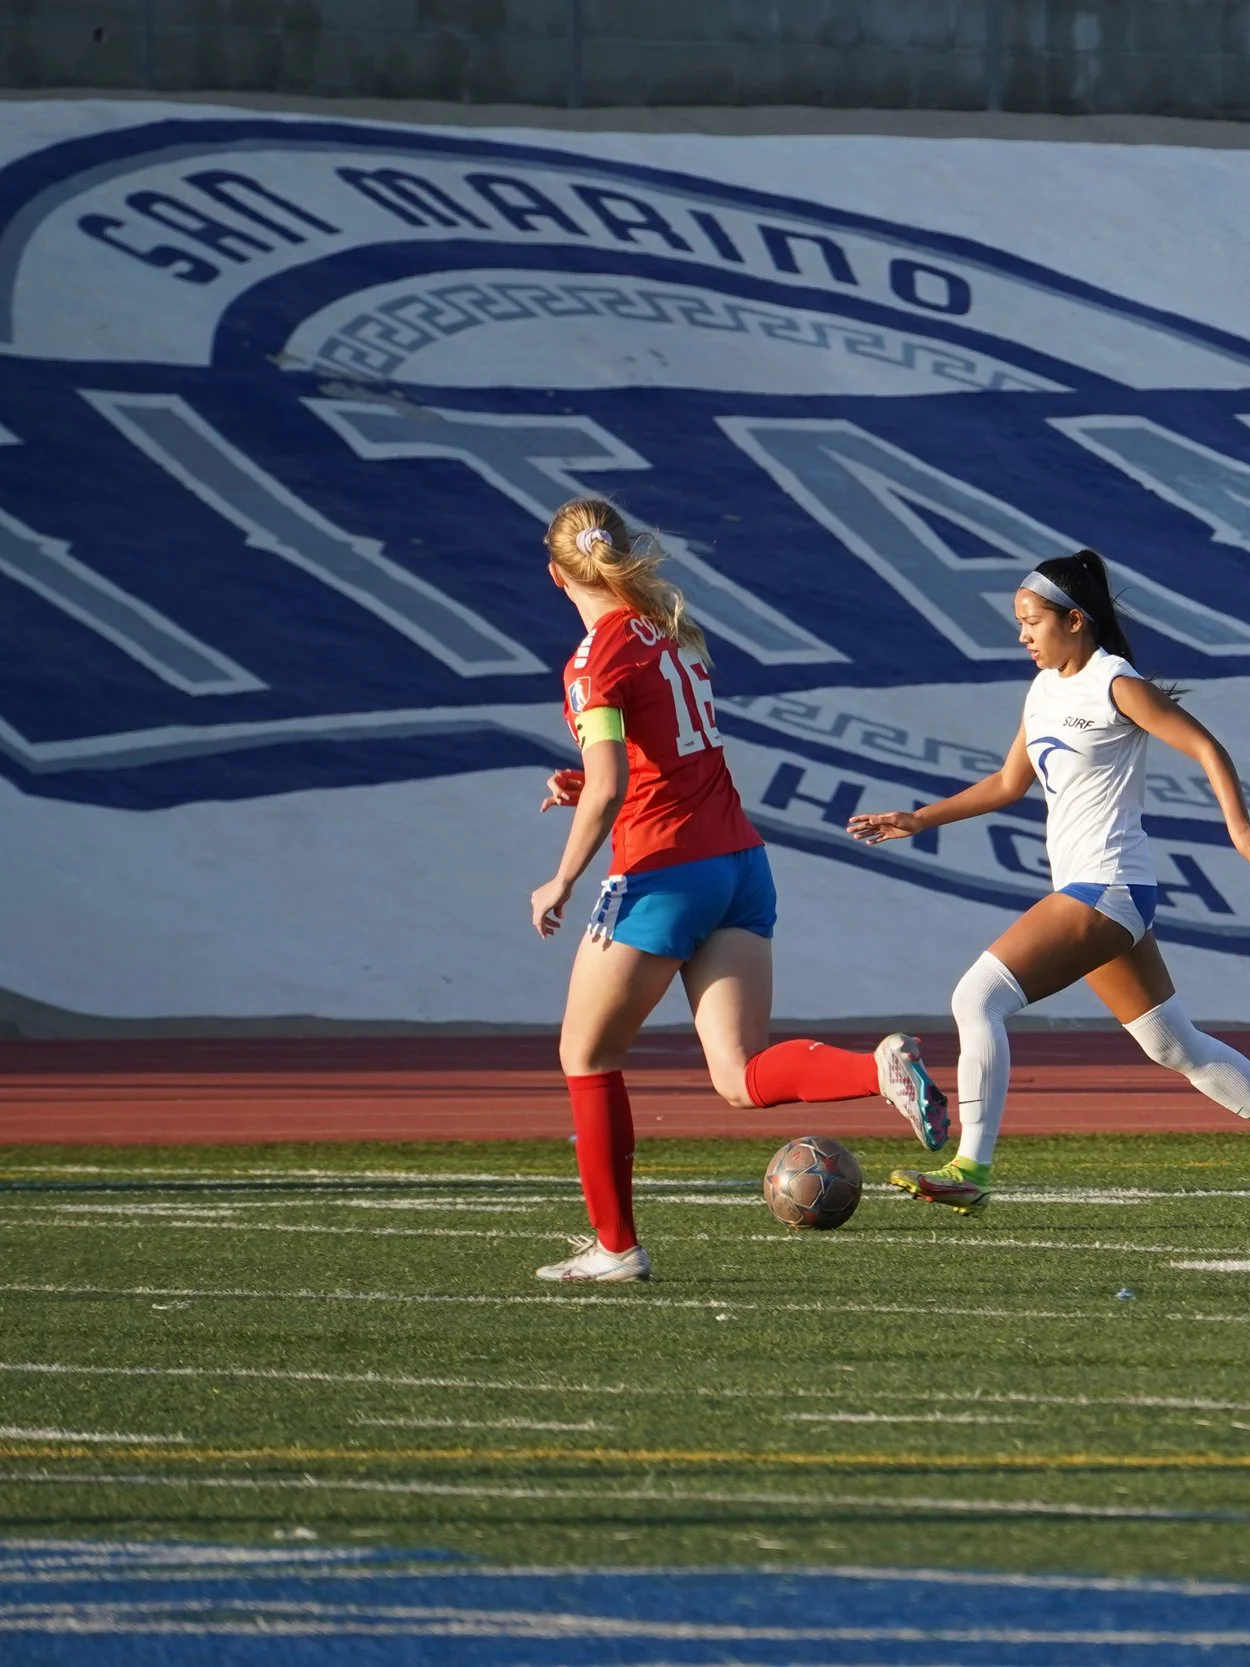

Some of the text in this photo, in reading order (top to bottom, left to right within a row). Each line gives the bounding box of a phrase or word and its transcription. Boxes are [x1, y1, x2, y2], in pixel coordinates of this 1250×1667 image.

[77, 166, 973, 318] SAN MARINO
[1062, 715, 1096, 730] SURF
